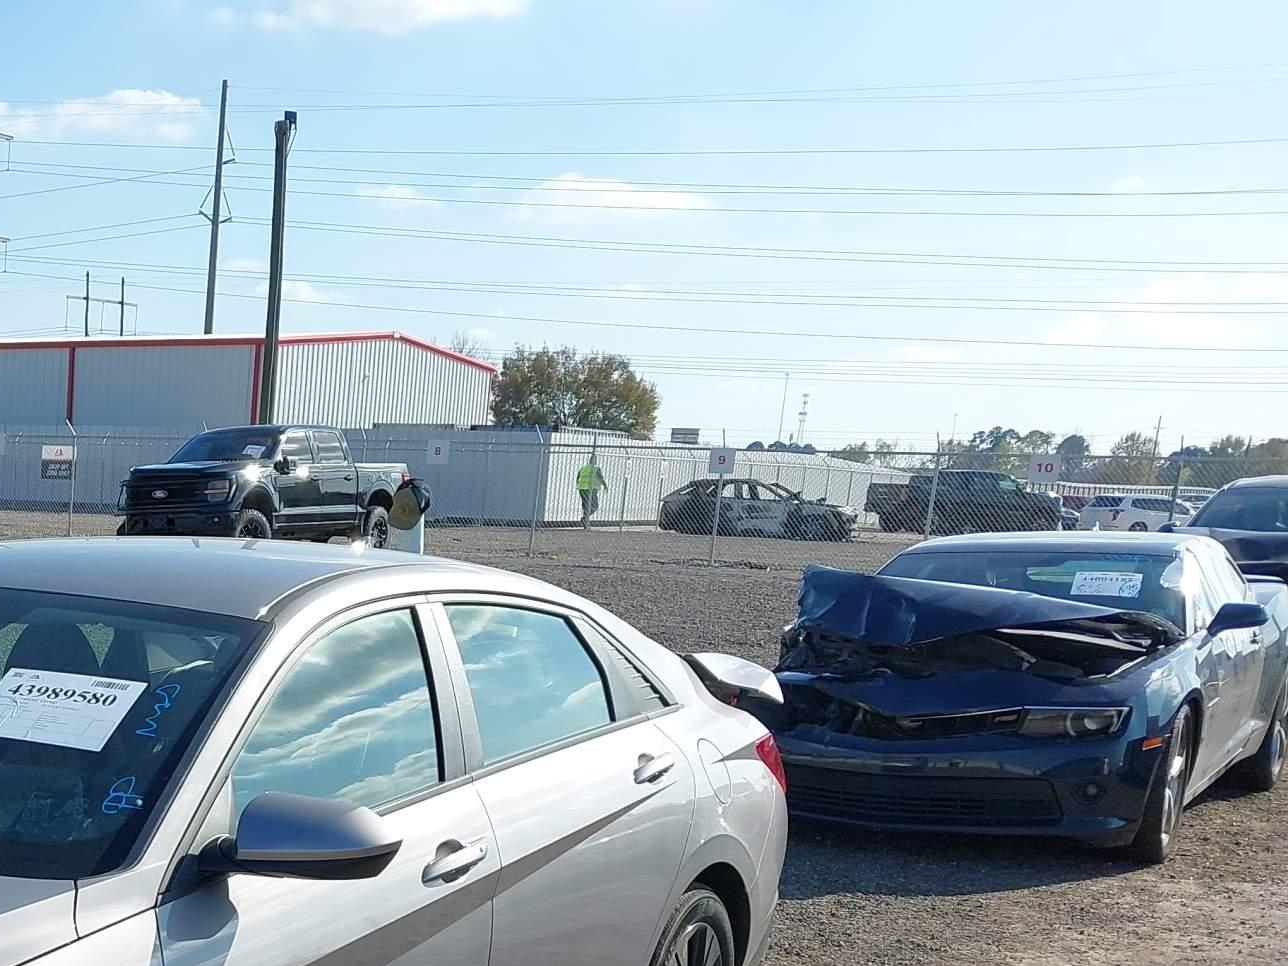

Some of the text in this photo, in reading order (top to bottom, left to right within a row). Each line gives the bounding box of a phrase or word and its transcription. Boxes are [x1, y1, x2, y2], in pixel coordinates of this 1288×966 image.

[718, 455, 726, 465] 9
[1036, 462, 1054, 473] 10
[8, 682, 118, 707] 43989580
